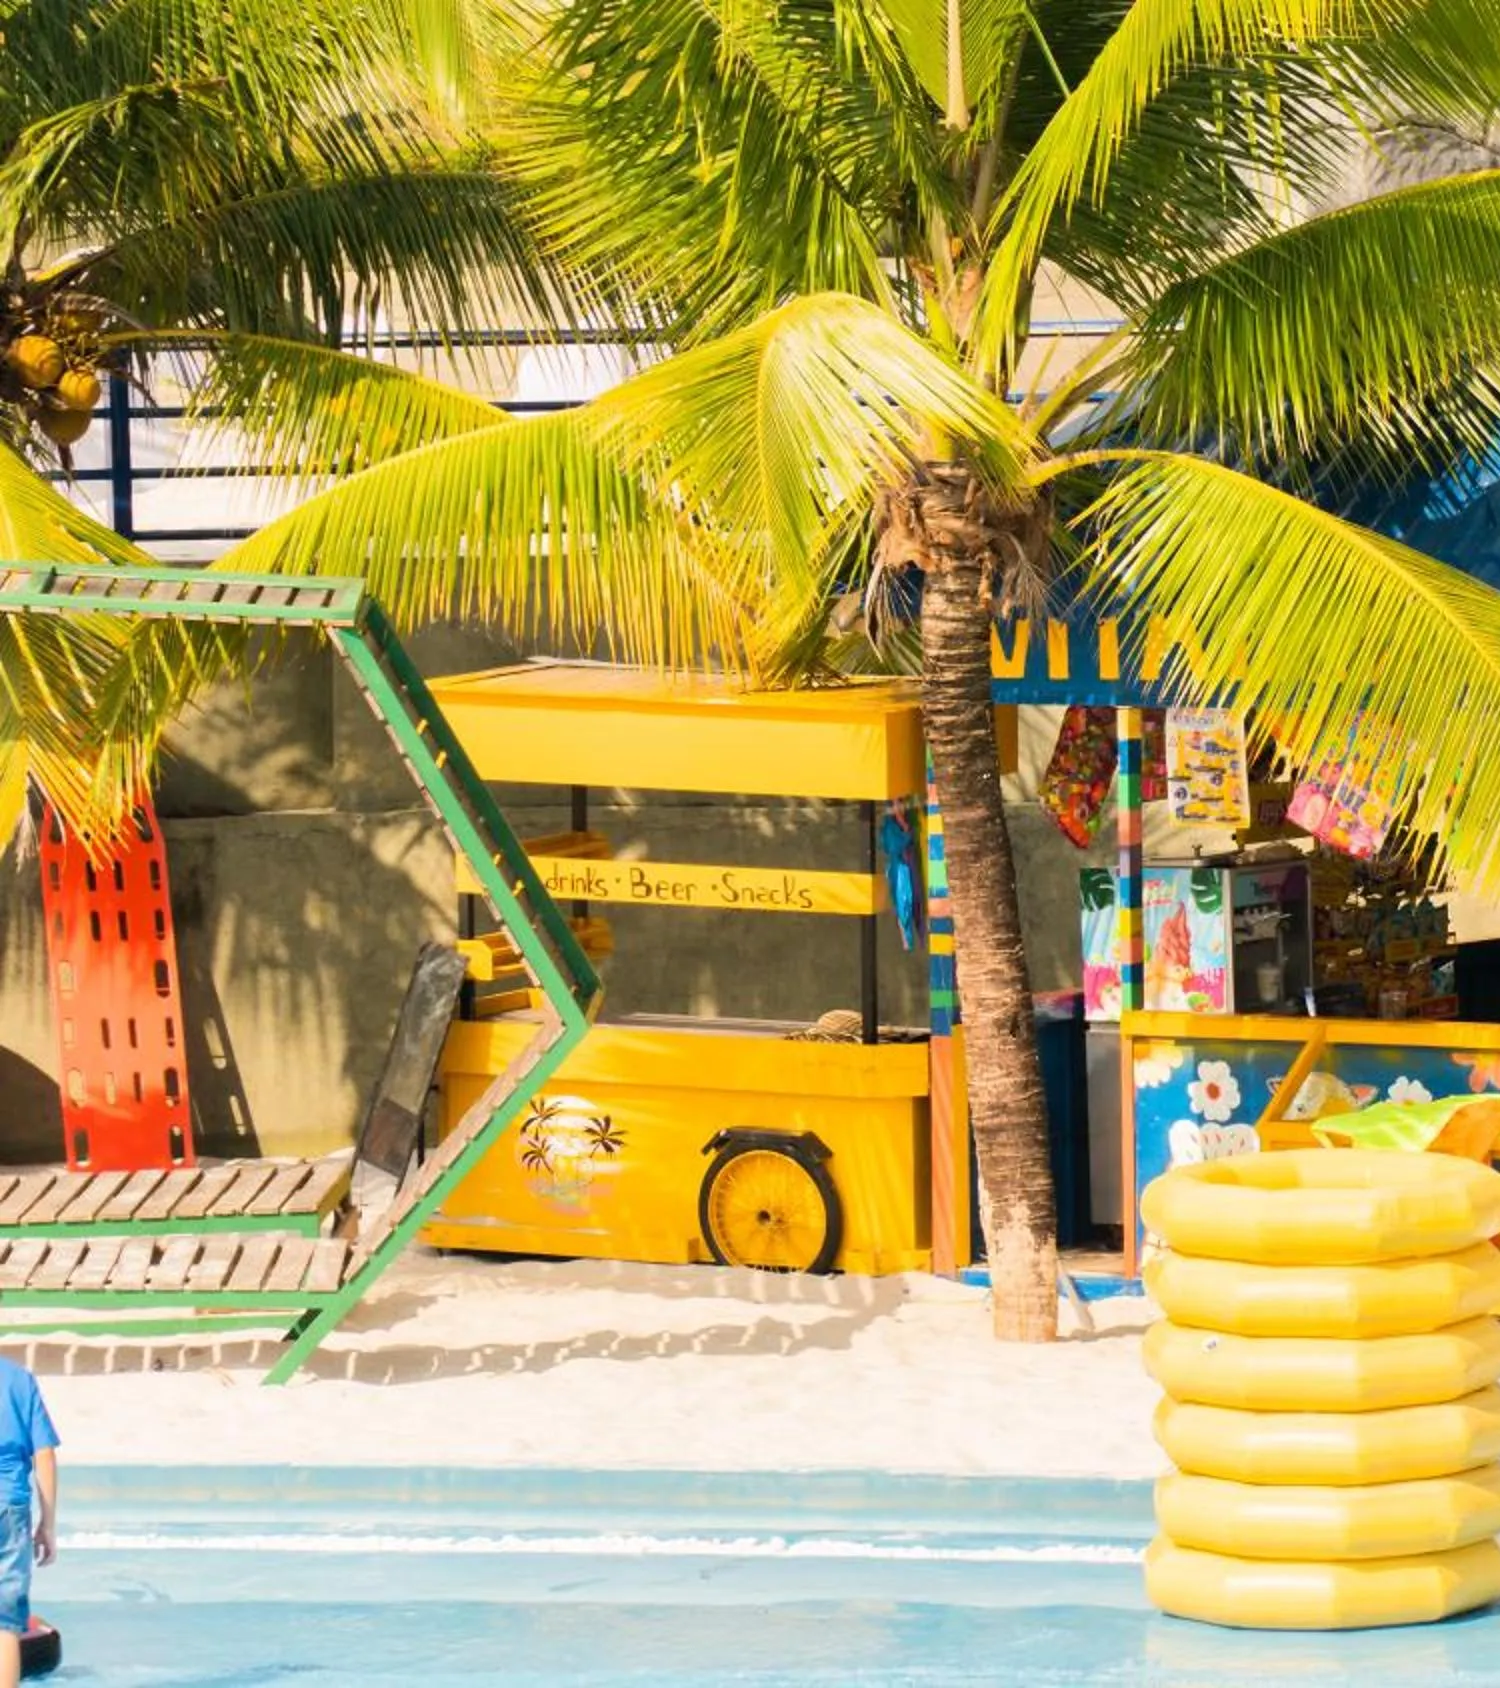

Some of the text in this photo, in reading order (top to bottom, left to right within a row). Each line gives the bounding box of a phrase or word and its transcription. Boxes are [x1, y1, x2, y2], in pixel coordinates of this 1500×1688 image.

[545, 862, 812, 909] drinks Beer Snacks
